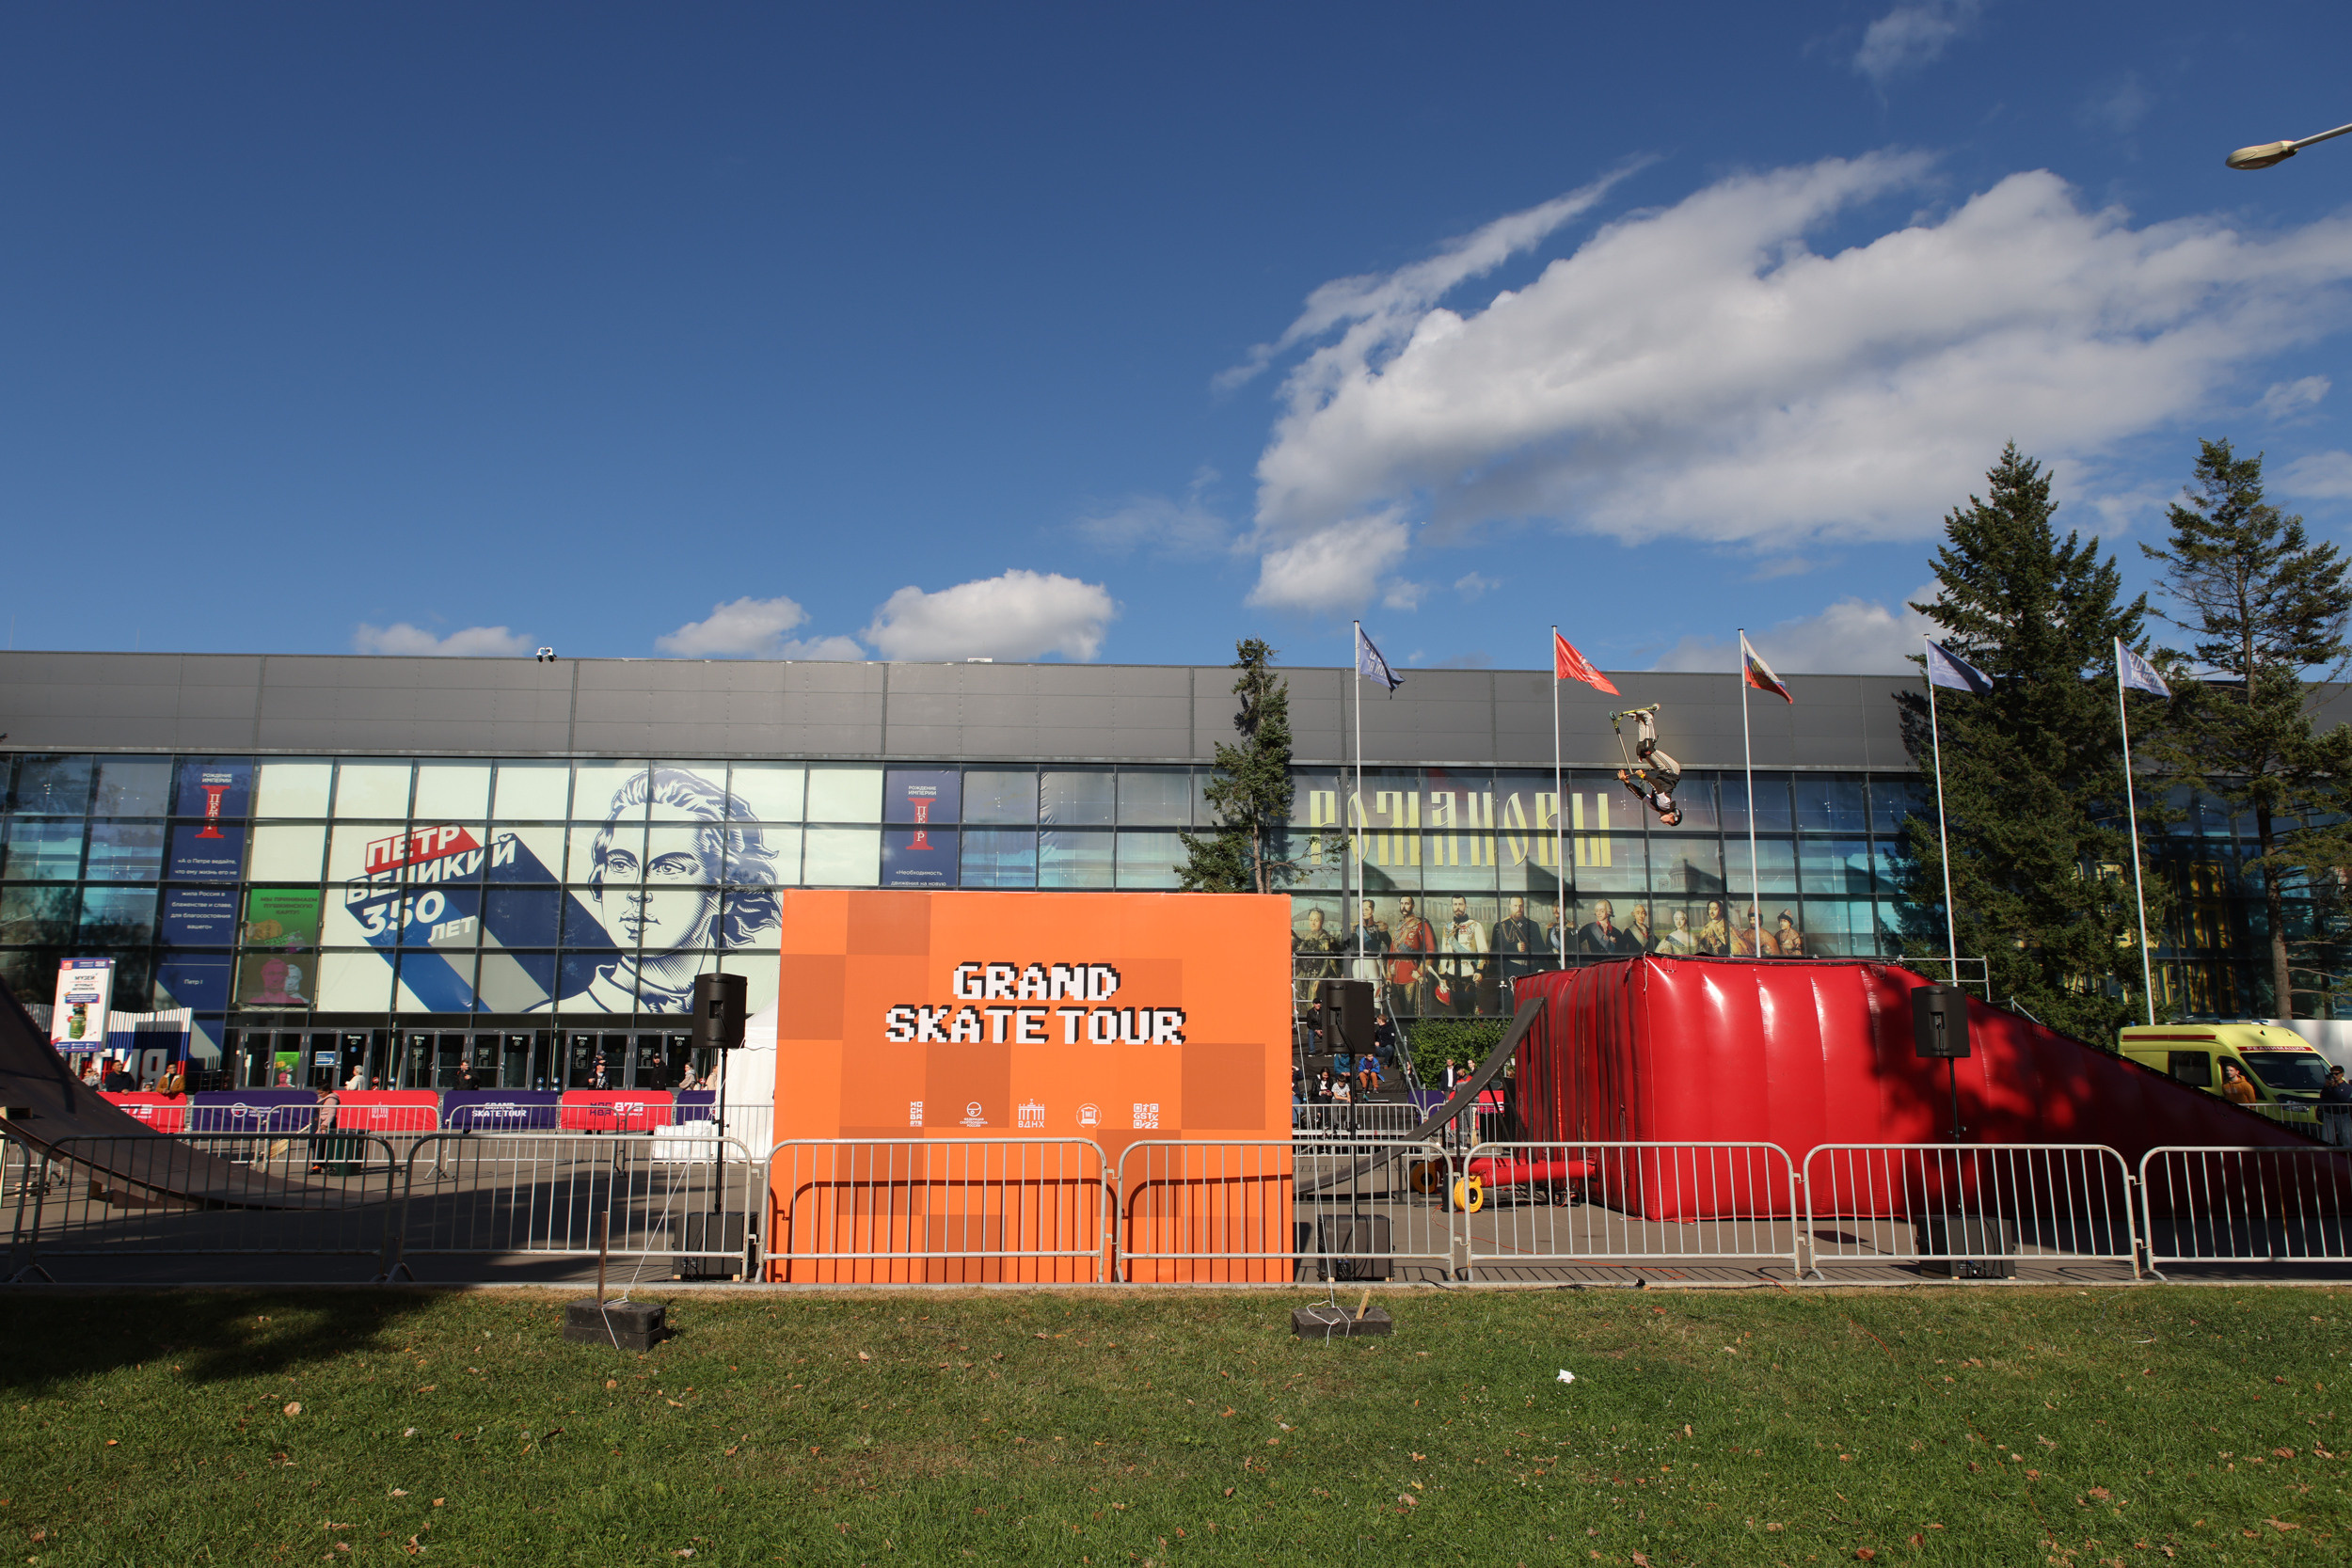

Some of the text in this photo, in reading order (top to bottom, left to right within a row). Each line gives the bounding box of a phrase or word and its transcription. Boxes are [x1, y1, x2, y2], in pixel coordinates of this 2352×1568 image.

[208, 793, 222, 830] ПЕТ
[916, 805, 927, 842] ПЕР
[365, 824, 461, 868] ПЕТР
[346, 833, 516, 905] ВЕЛИКИЙ
[361, 891, 445, 938] 350
[427, 915, 477, 942] ЛЕТ
[952, 961, 1121, 1001] GRAND
[885, 1004, 1187, 1045] SKATE TOUR
[613, 1101, 644, 1112] 875
